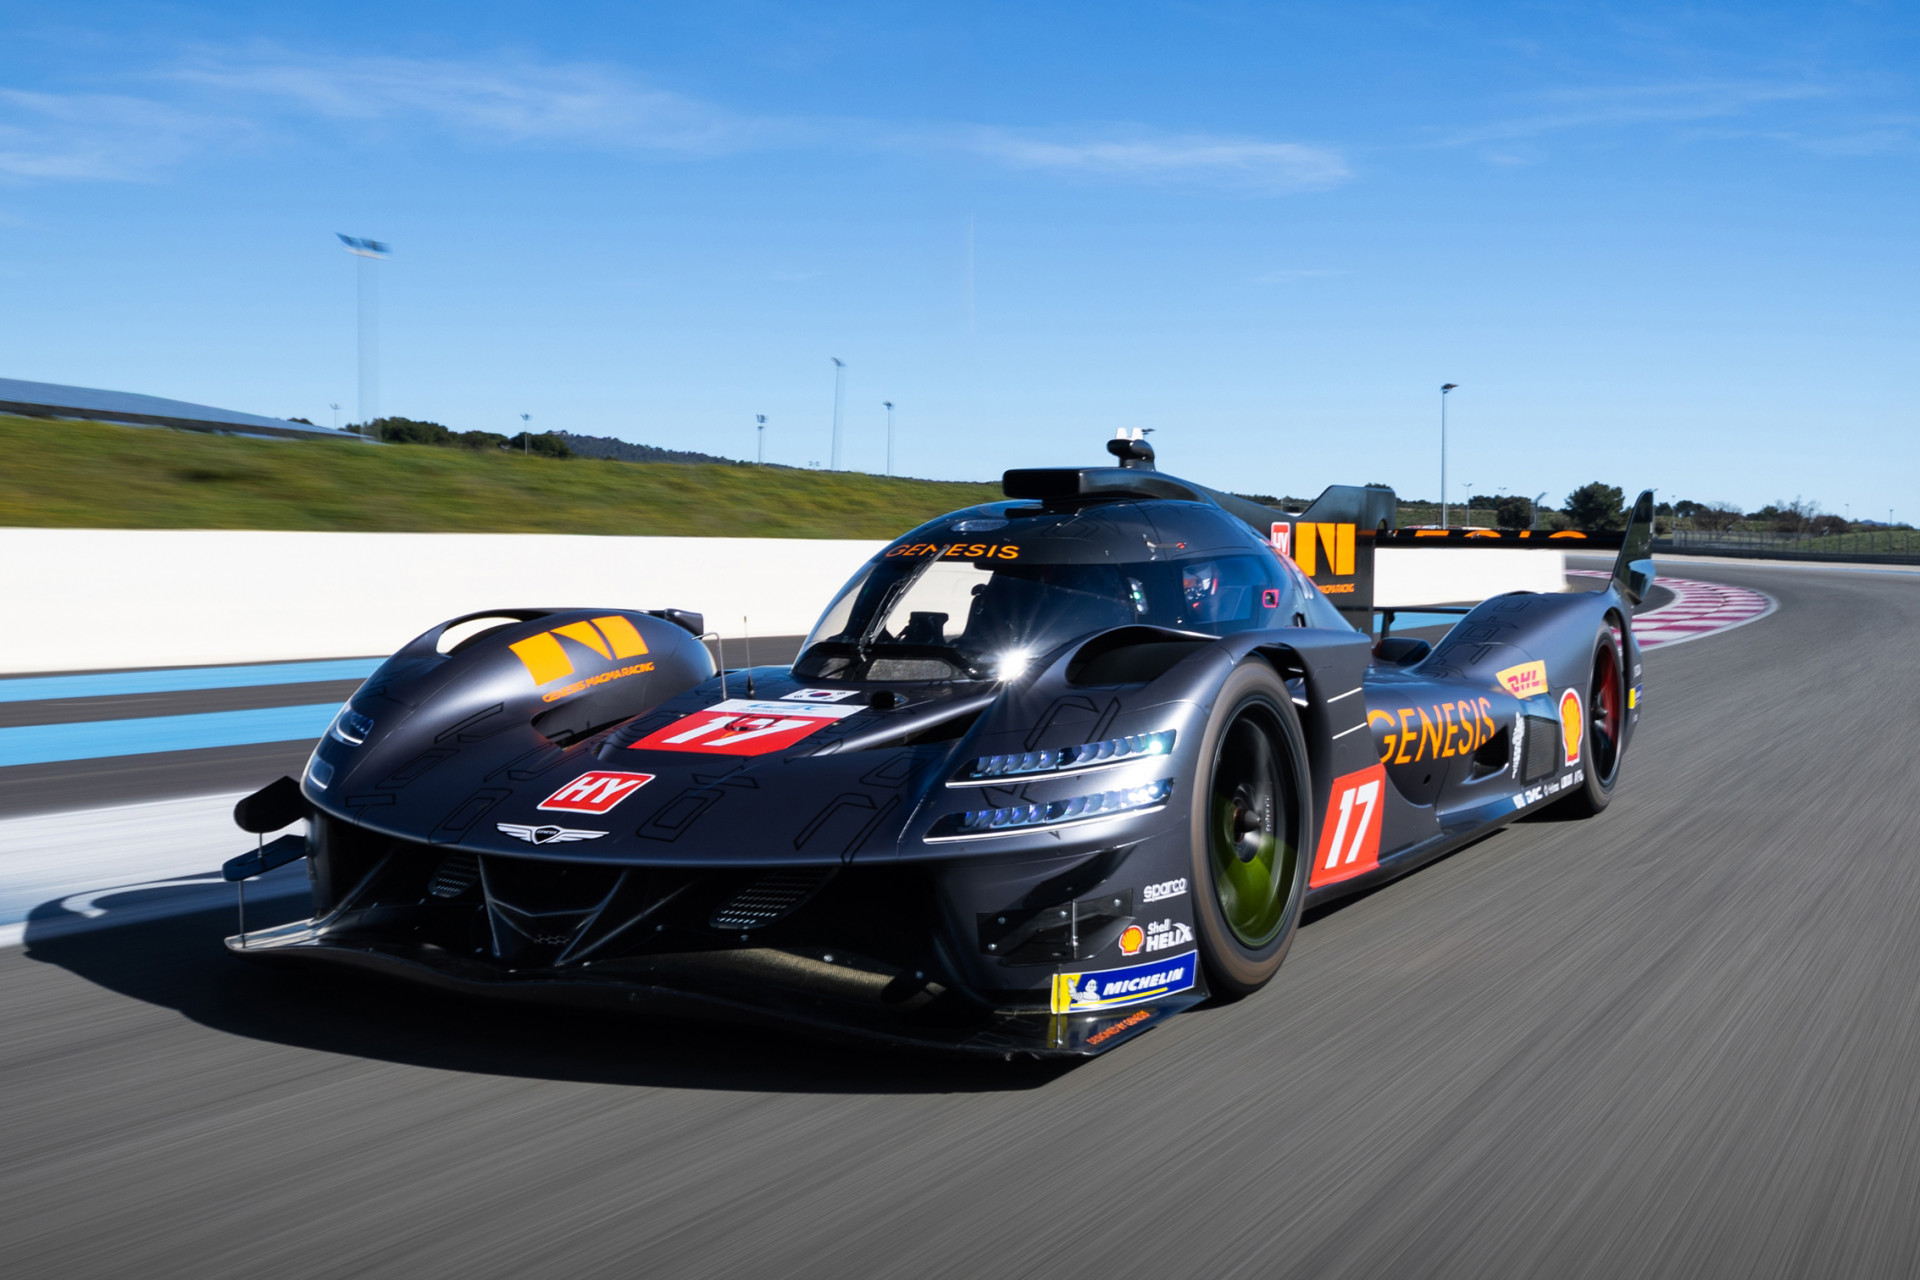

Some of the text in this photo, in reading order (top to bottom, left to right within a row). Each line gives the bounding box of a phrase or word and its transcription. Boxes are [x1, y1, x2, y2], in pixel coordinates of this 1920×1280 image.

[585, 669, 622, 687] MAGMA
[620, 661, 655, 677] RACING
[1507, 670, 1541, 692] DHL
[661, 715, 816, 747] 17
[1367, 696, 1496, 765] GENESIS
[553, 776, 642, 804] HY
[1325, 779, 1380, 870] 17
[1143, 877, 1188, 902] sparco
[1146, 922, 1193, 952] HELIX
[1147, 918, 1172, 935] Shell
[1102, 966, 1185, 996] MICHELIN
